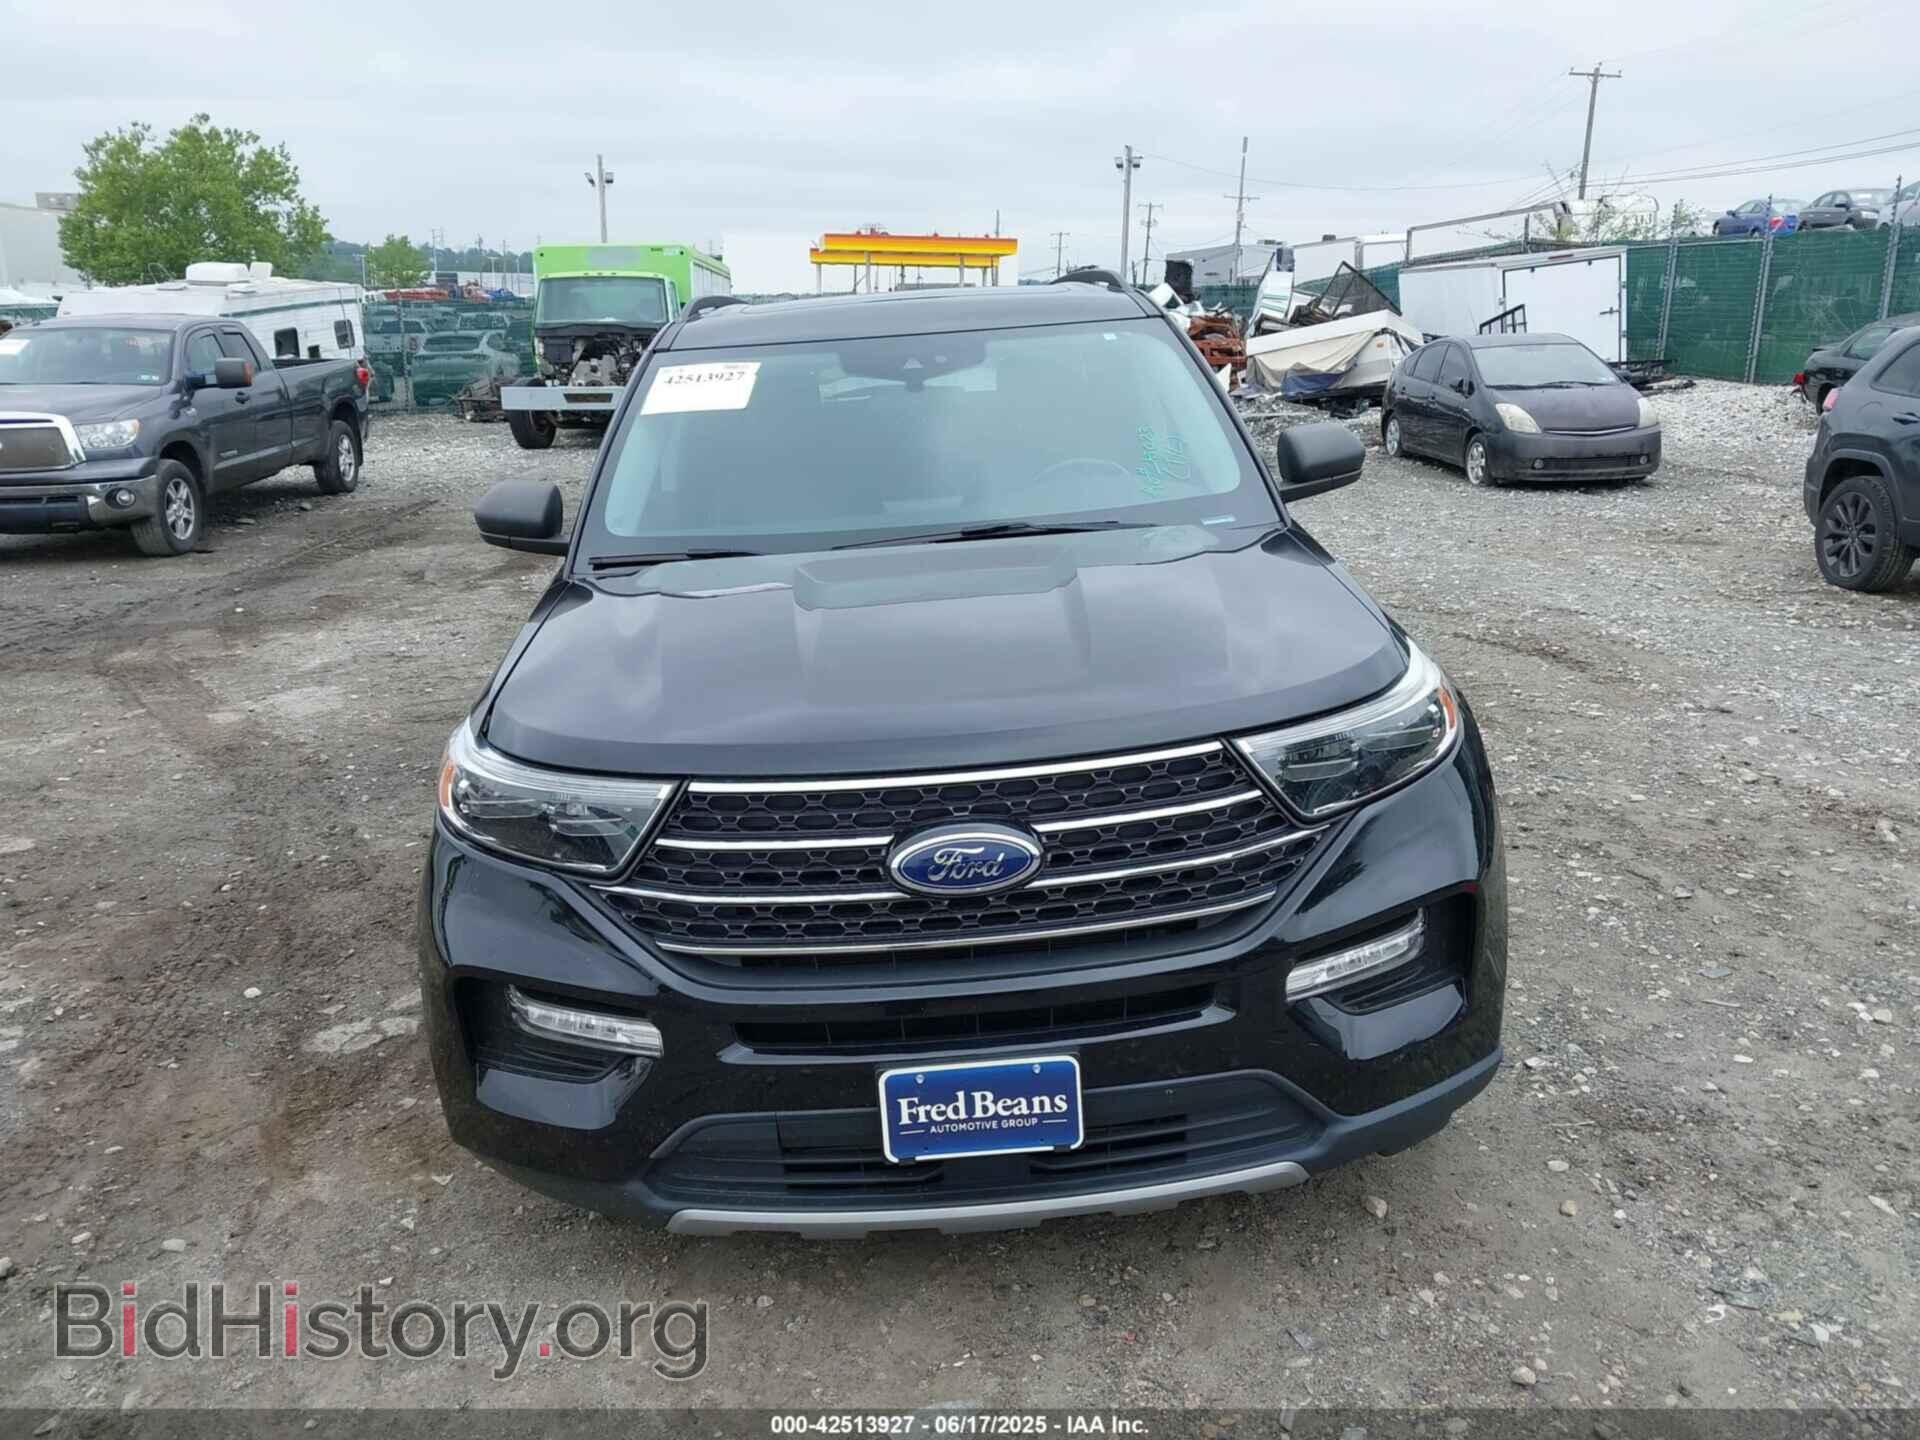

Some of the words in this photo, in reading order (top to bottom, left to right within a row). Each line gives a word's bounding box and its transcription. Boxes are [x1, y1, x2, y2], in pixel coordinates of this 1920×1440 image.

[928, 847, 1005, 881] Ford
[897, 1090, 968, 1125] Fred
[971, 1090, 1068, 1118] Beans
[930, 1120, 998, 1134] AUTOMOTIVE
[1001, 1117, 1038, 1128] GROUP
